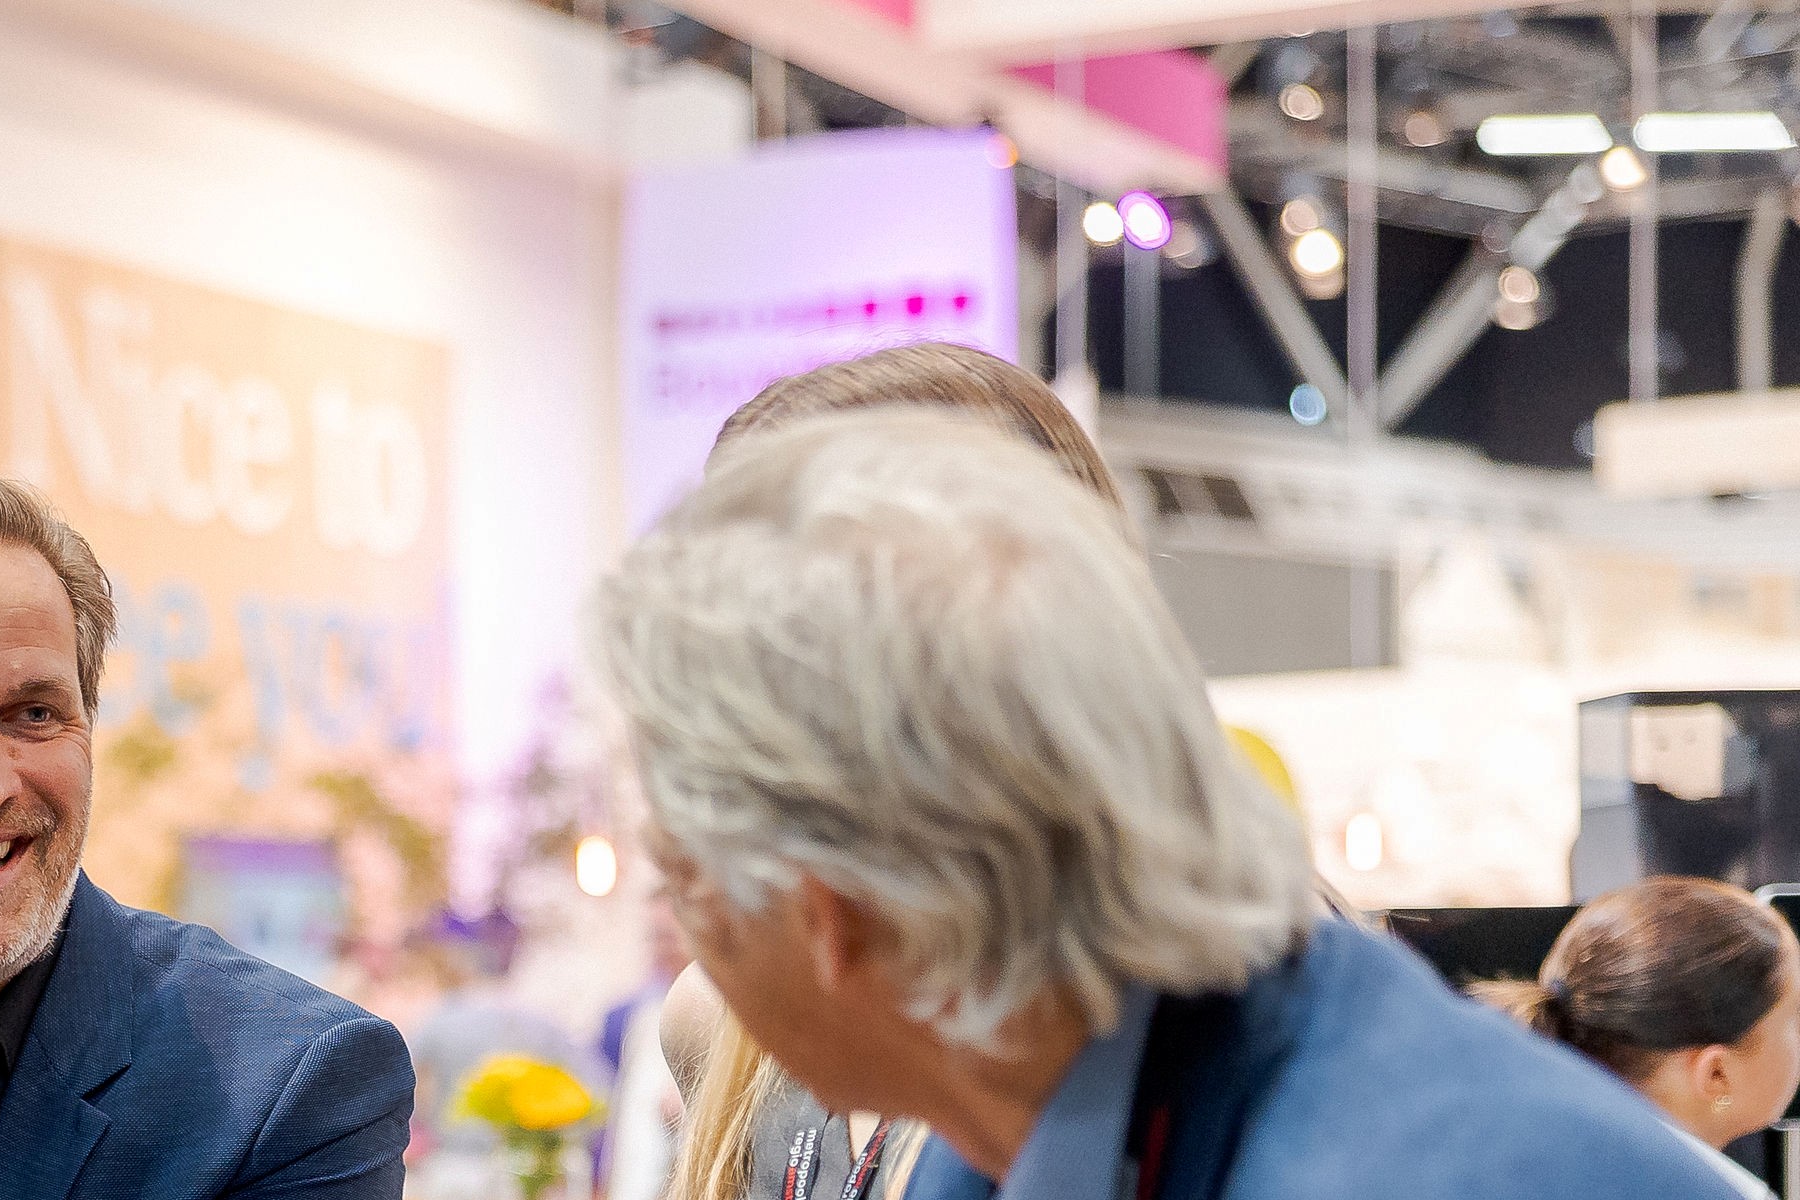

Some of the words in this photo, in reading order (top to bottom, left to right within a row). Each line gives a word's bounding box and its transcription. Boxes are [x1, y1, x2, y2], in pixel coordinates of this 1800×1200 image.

[10, 267, 292, 534] Nice
[312, 380, 429, 557] to
[795, 1127, 817, 1200] metropool
